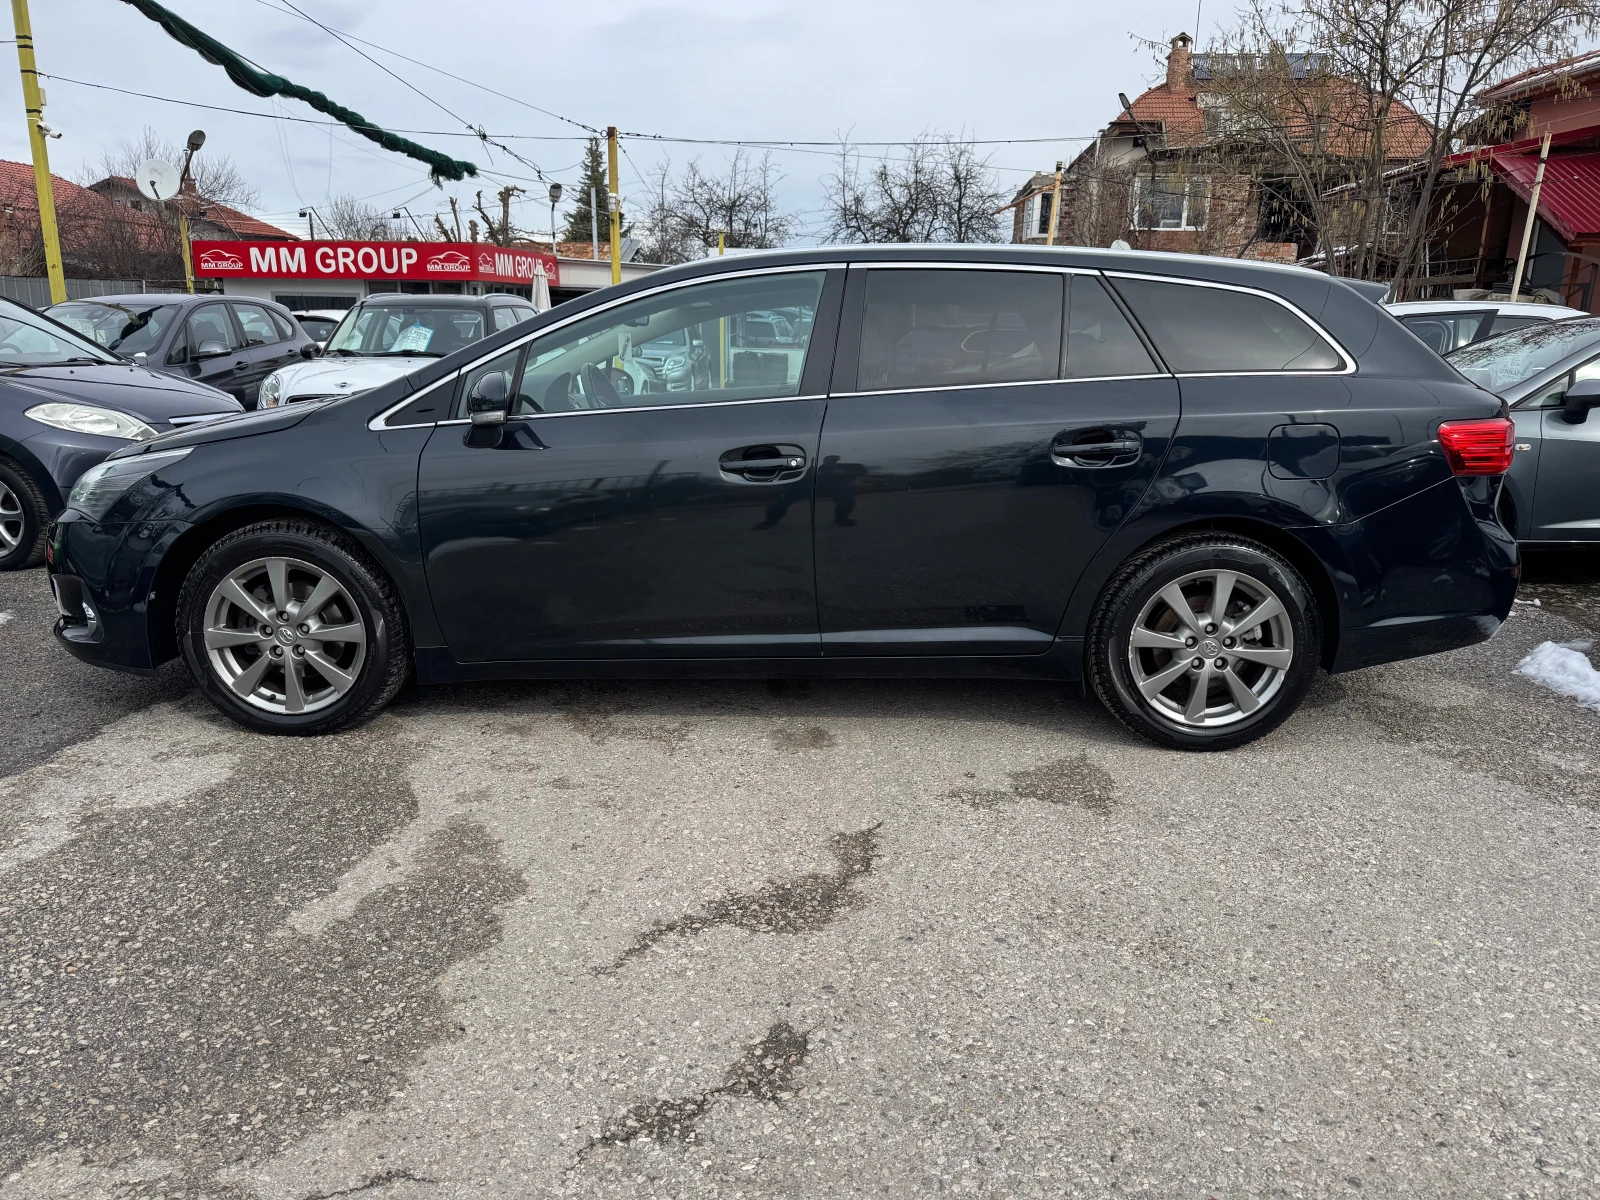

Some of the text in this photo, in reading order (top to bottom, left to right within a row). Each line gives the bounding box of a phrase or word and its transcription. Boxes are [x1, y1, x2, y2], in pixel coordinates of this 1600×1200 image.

[217, 261, 244, 269] GROUP
[249, 247, 418, 274] MM GROUP
[494, 252, 515, 277] MM
